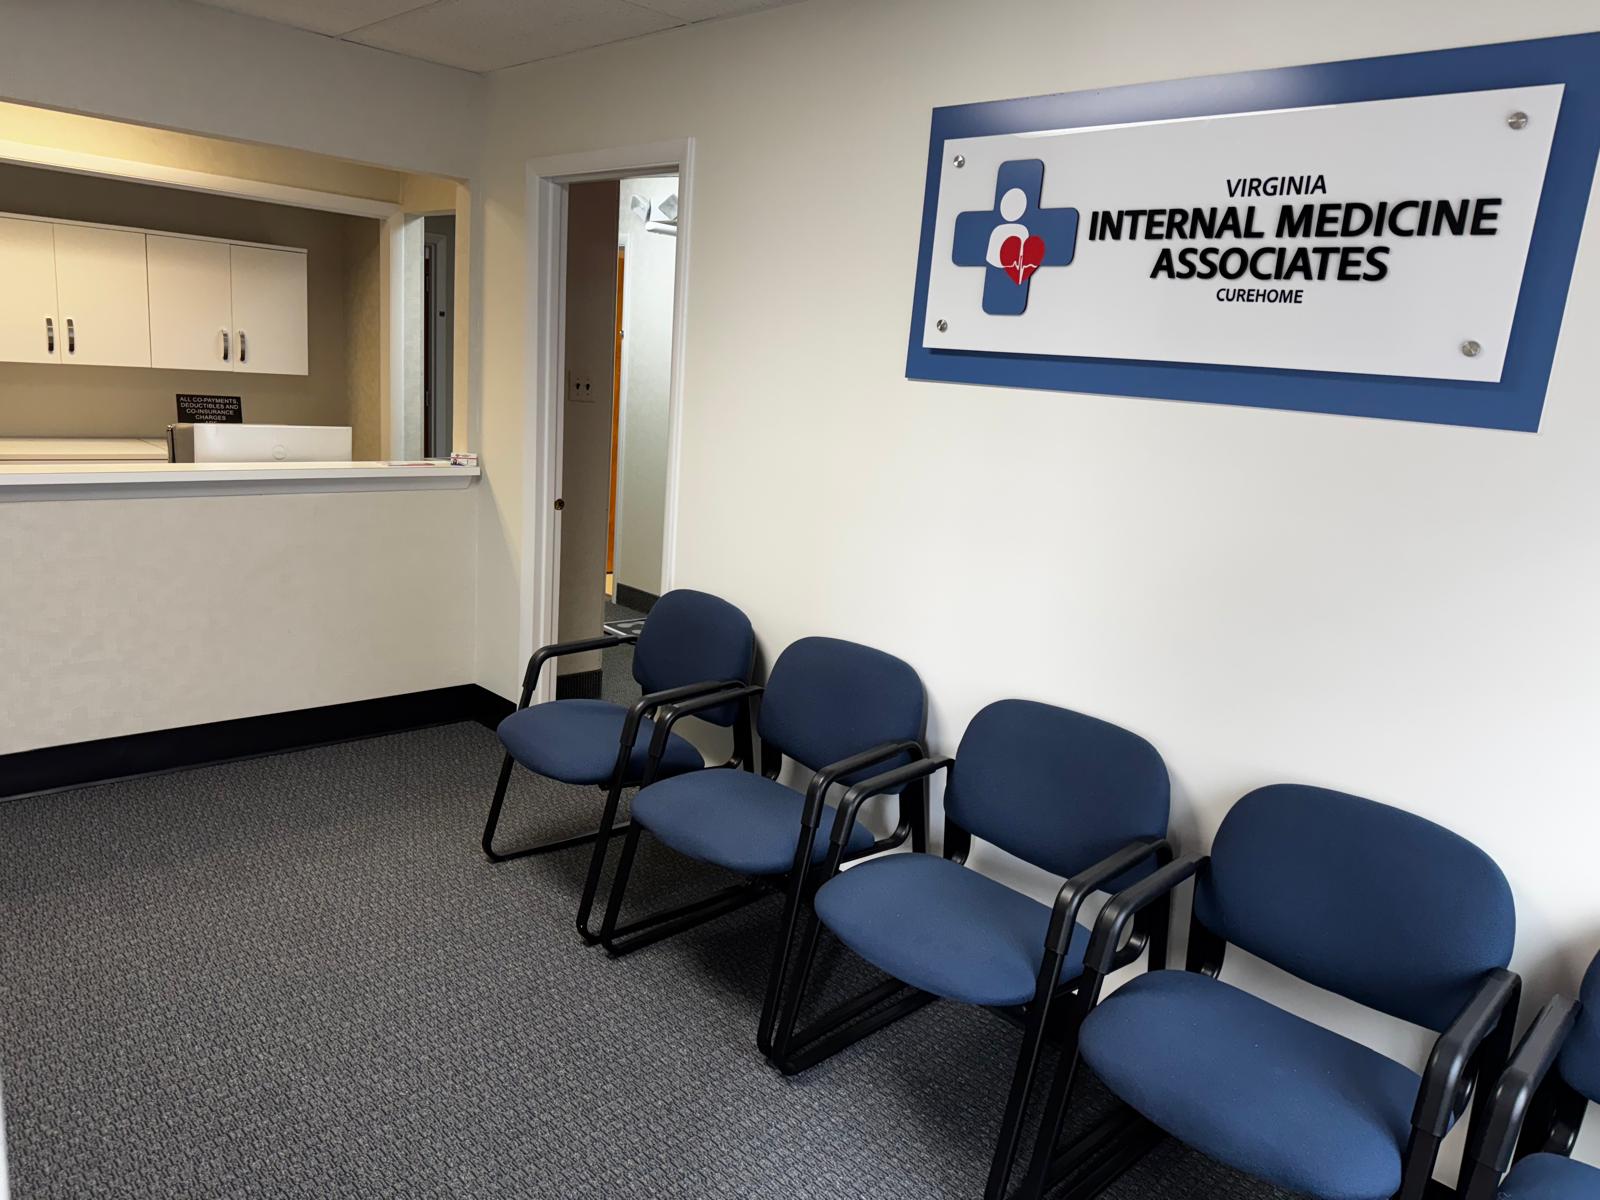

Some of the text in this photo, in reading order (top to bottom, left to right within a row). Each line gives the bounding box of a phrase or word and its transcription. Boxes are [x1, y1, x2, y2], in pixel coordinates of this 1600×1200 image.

[1227, 174, 1326, 197] VIRGINIA
[1089, 198, 1503, 241] INTERNAL MEDICINE
[1150, 246, 1390, 281] ASSOCIATES
[1217, 288, 1304, 304] CUREHOME
